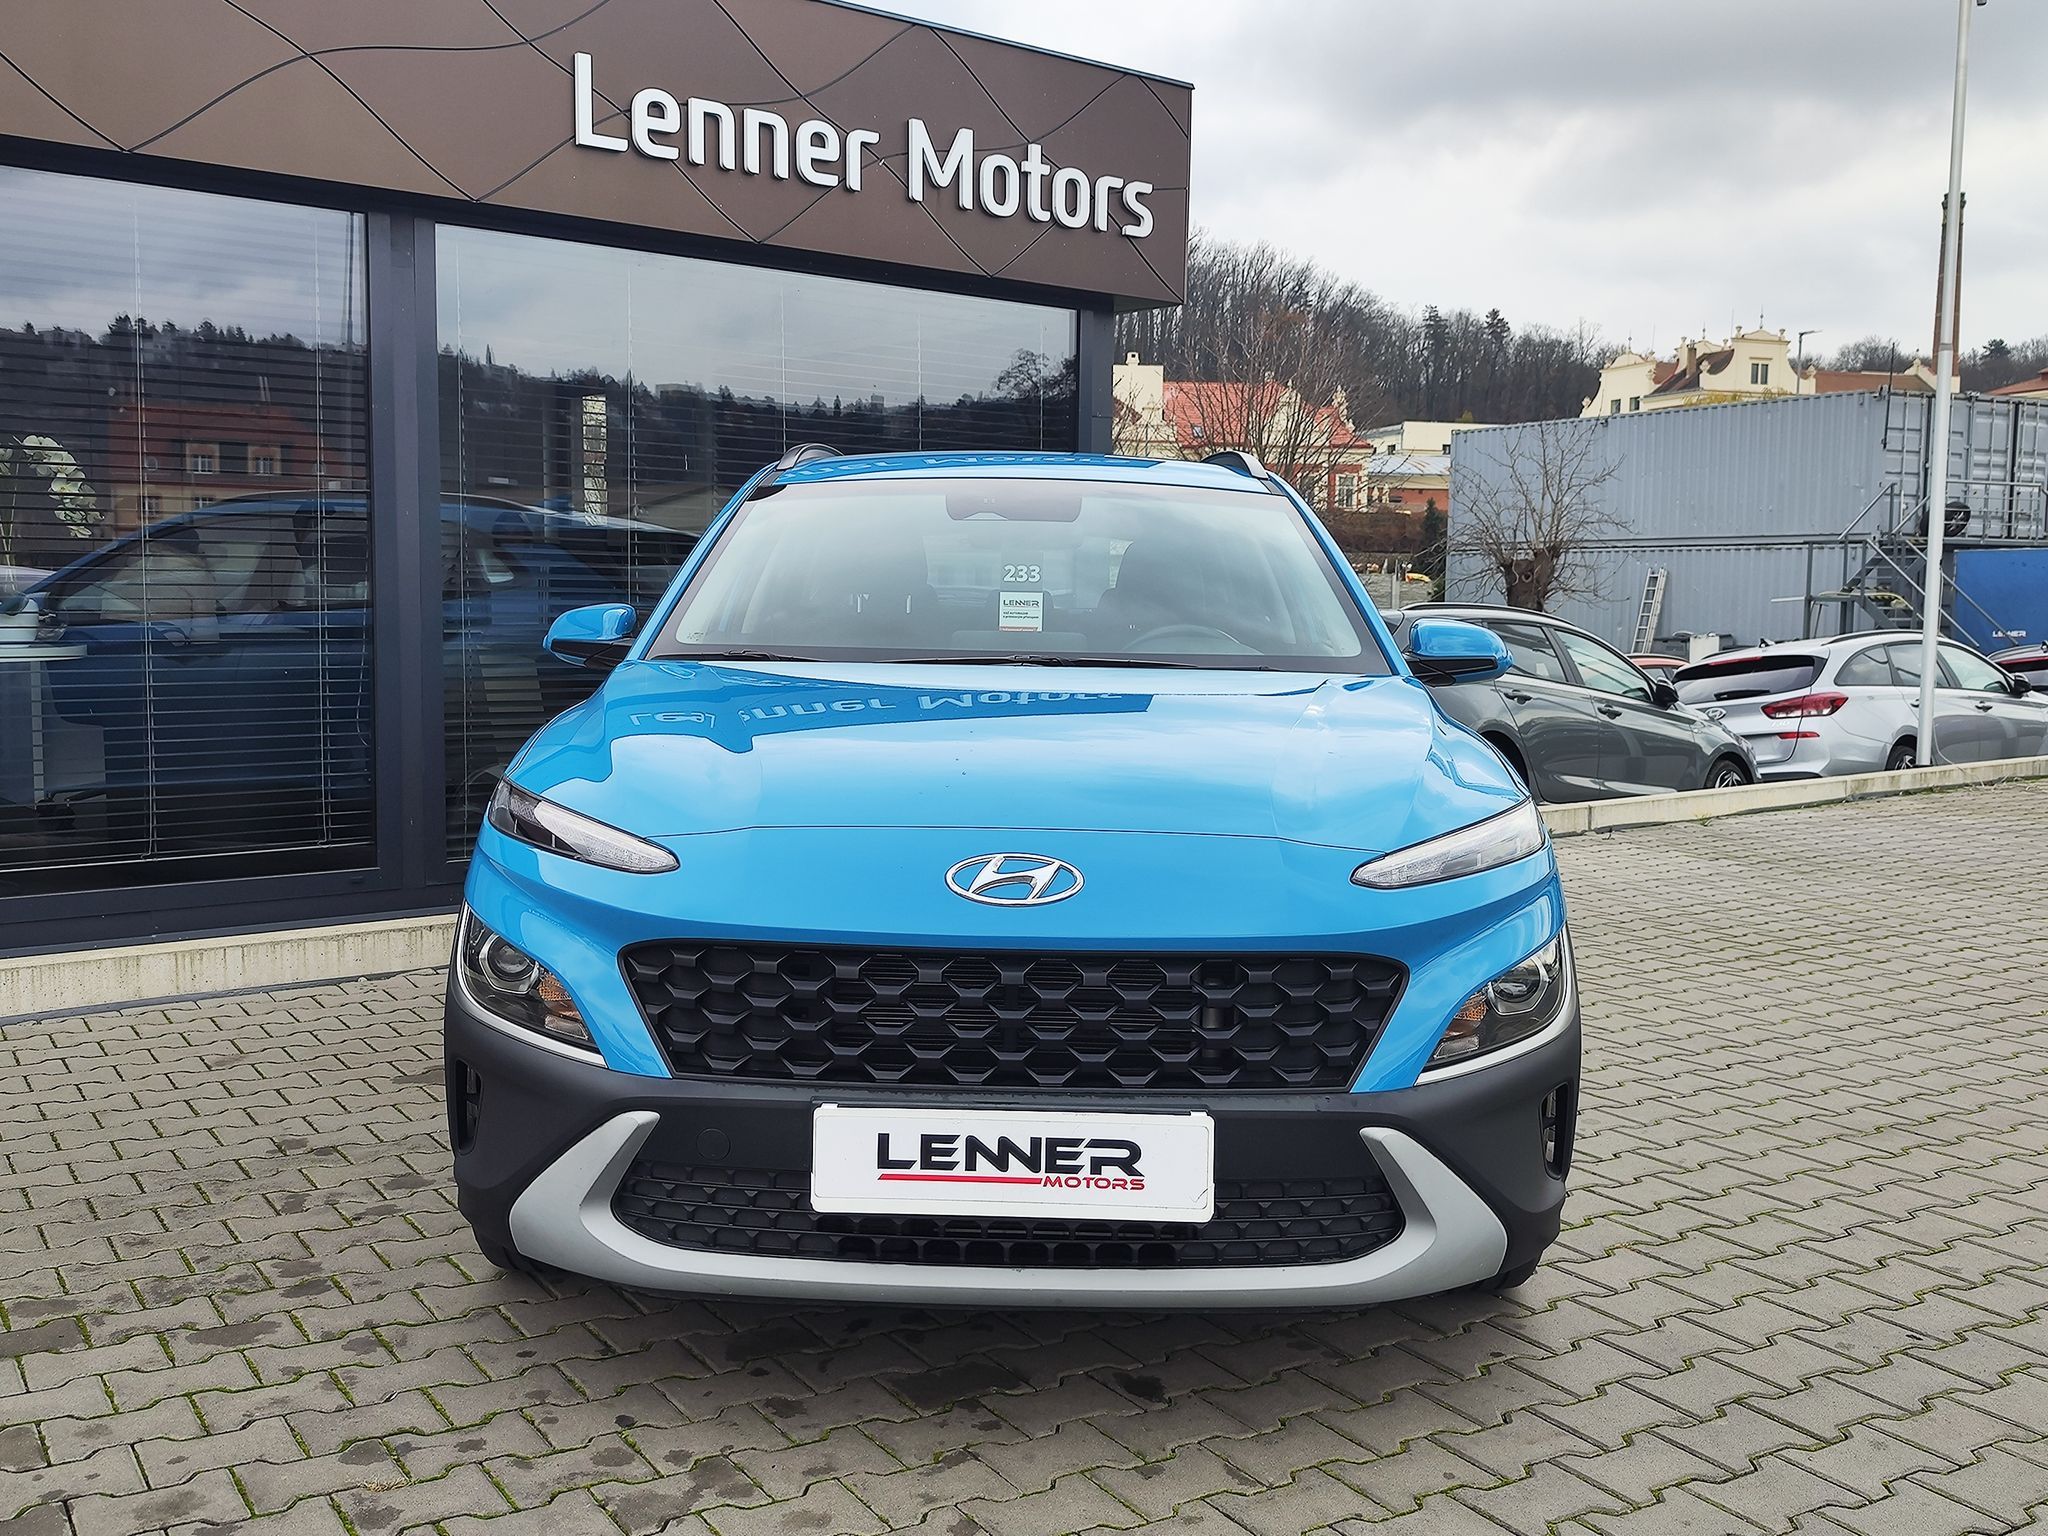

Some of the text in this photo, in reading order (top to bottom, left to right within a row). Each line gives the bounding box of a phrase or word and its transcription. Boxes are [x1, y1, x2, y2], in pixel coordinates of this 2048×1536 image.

[573, 51, 1155, 239] Lenner Motors
[1003, 564, 1041, 582] 233
[877, 1132, 1145, 1177] LENNER
[1042, 1175, 1146, 1191] MOTORS
